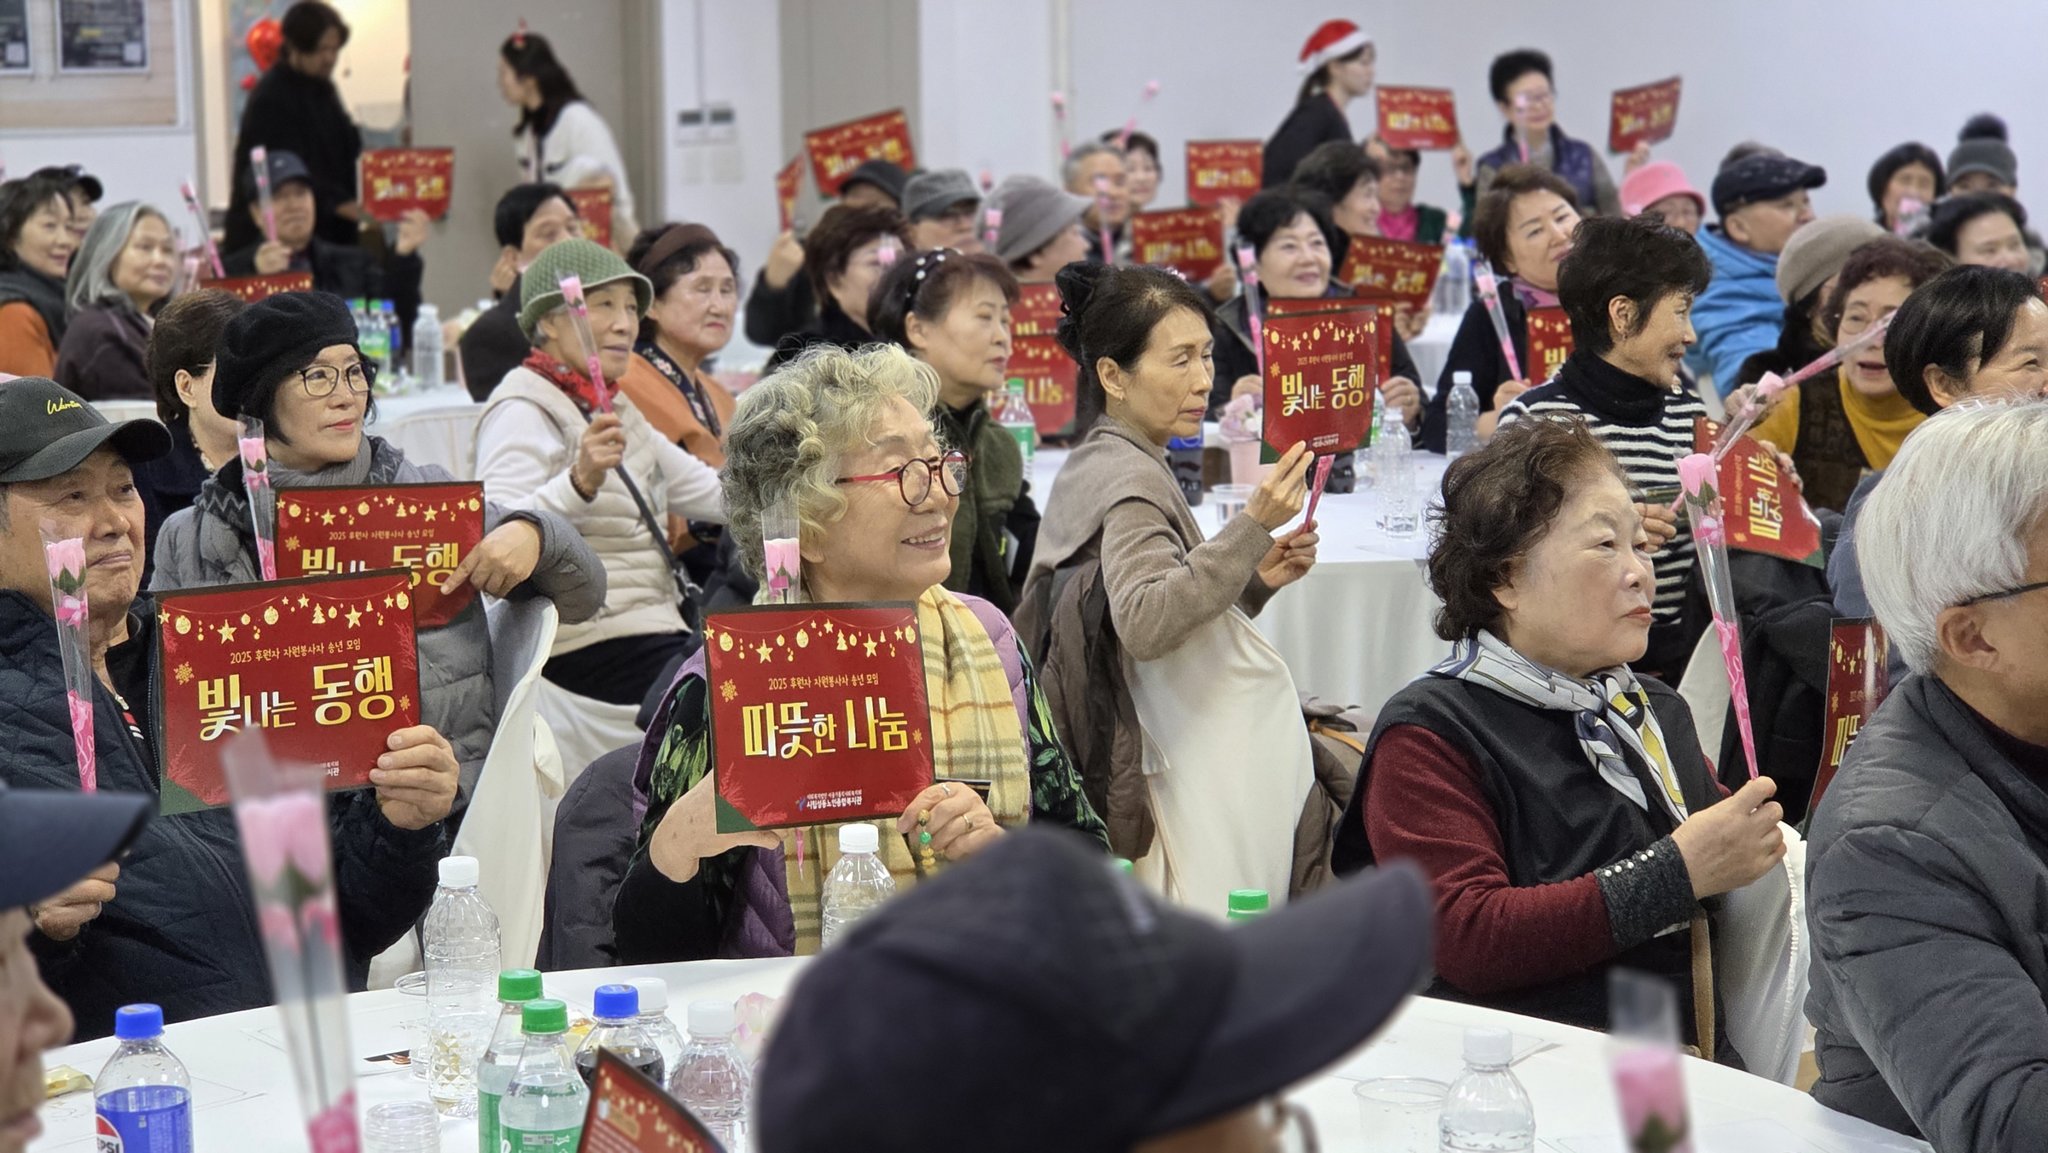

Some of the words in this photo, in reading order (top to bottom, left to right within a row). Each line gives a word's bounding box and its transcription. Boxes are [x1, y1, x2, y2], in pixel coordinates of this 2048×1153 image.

[1281, 371, 1326, 416] 빛나는
[1331, 363, 1366, 410] 동행
[1748, 487, 1784, 541] 따뜻한
[391, 542, 459, 587] 동행
[229, 651, 253, 664] 2025
[255, 647, 280, 661] 후원자
[283, 642, 325, 658] 자원봉사자
[327, 640, 344, 653] 송년
[346, 637, 361, 651] 모임
[198, 674, 298, 741] 빛나는
[311, 655, 395, 726] 동행
[768, 677, 788, 690] 2025
[790, 676, 811, 689] 후원자
[814, 674, 849, 688] 자원봉사자
[851, 673, 865, 686] 송년
[866, 672, 879, 685] 모임
[742, 702, 837, 759] 따뜻한
[845, 696, 908, 751] 나눔
